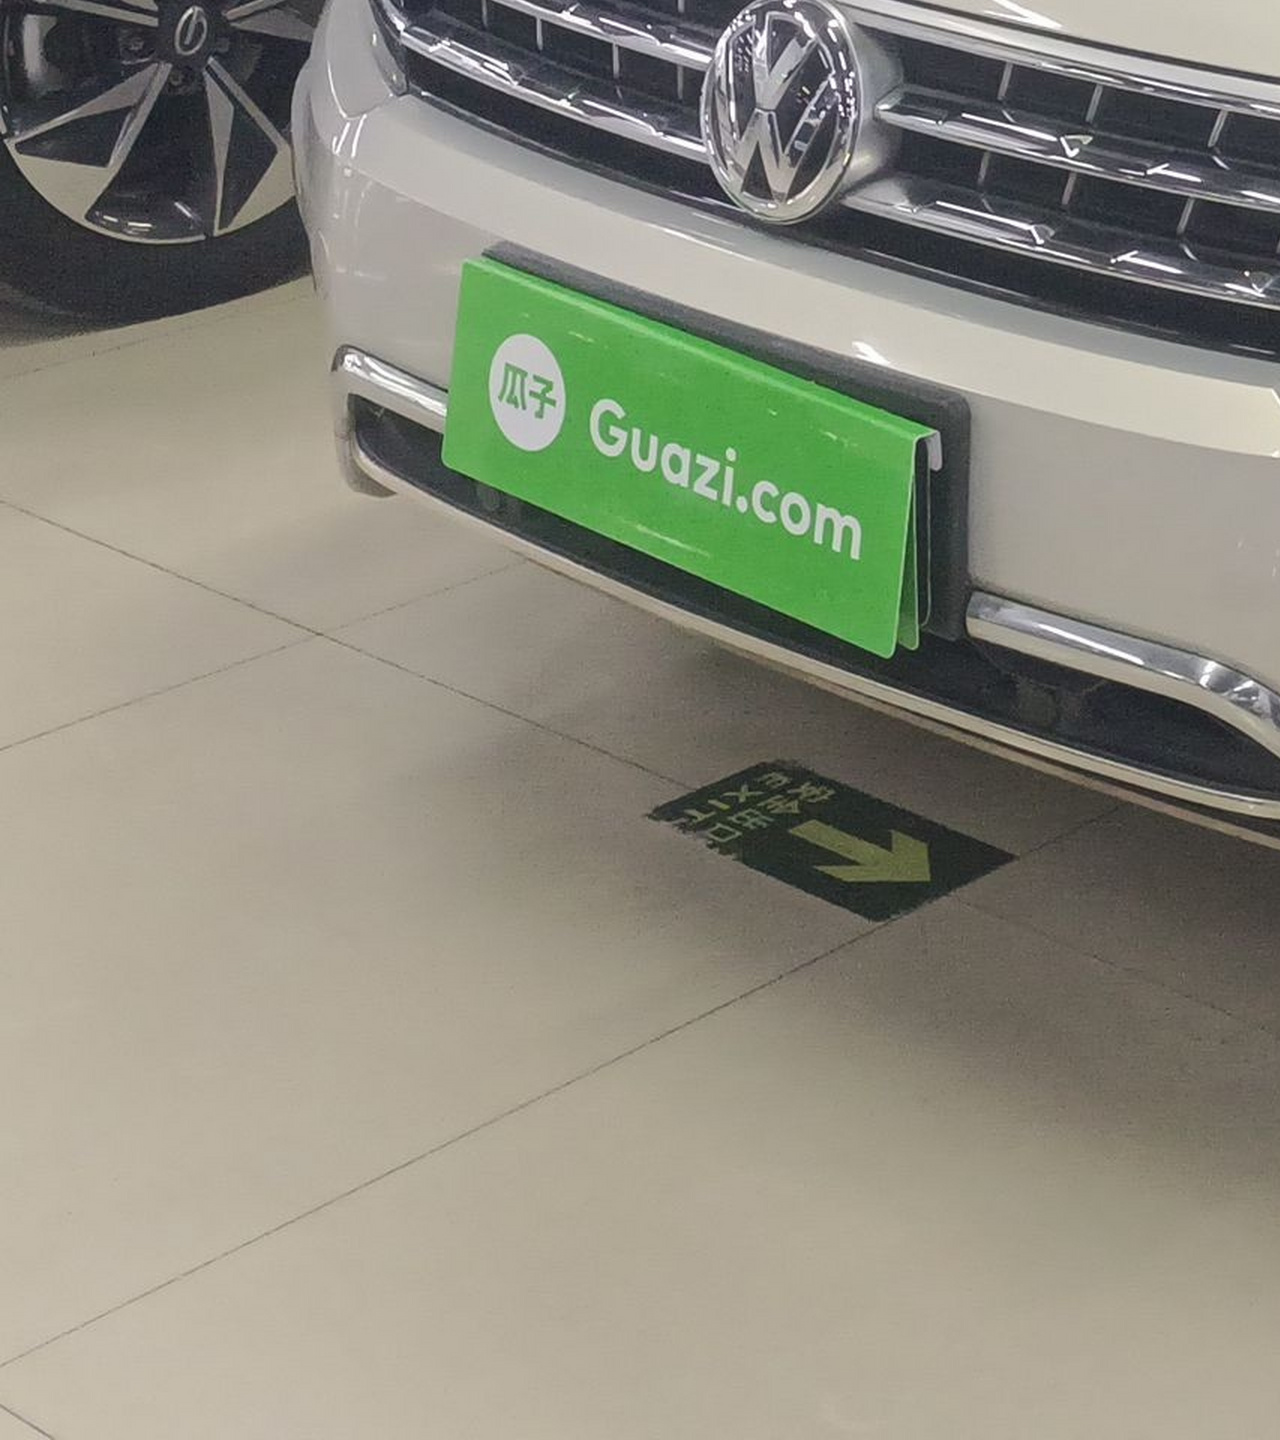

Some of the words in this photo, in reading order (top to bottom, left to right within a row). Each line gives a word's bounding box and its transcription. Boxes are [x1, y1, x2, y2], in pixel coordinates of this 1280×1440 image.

[497, 361, 557, 421] 瓜子
[589, 398, 864, 562] Guazi.com
[684, 771, 792, 823] EXIT
[708, 781, 837, 844] 安全出口
